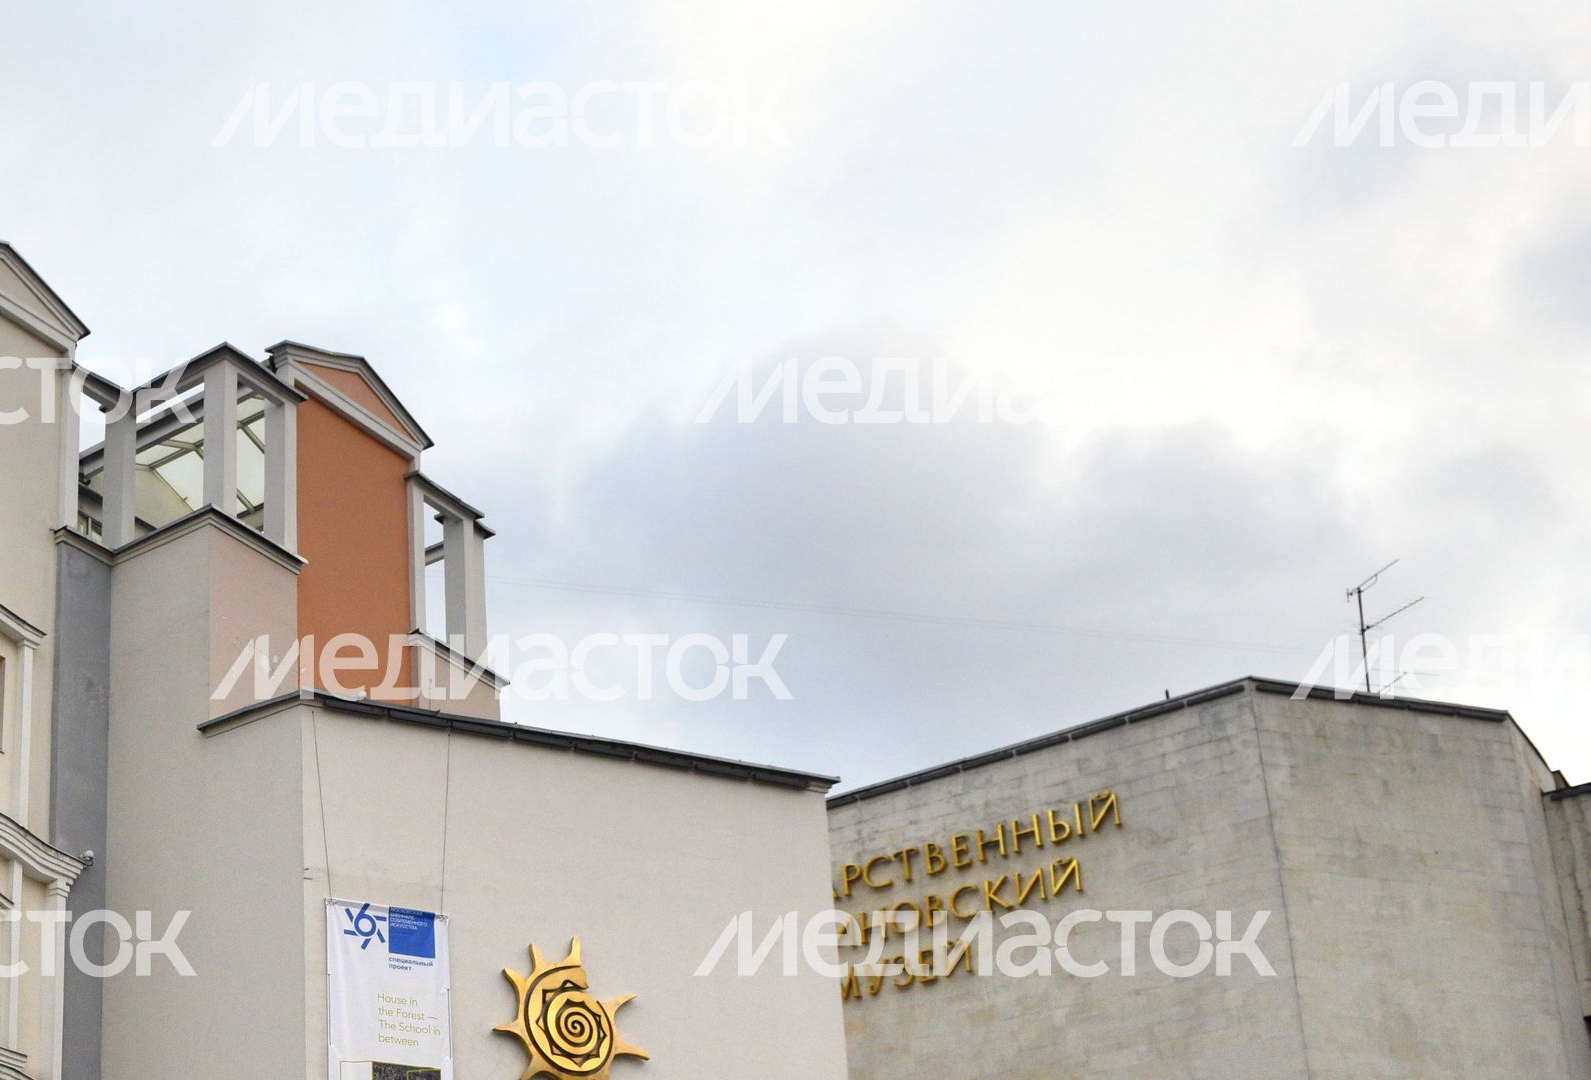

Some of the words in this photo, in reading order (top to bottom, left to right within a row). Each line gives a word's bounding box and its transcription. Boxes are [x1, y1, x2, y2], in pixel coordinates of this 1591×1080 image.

[832, 790, 1123, 899] РСТВЕННЫЙ
[389, 957, 434, 967] специальный
[389, 963, 412, 971] проект
[377, 992, 407, 1005] House
[409, 997, 418, 1006] in
[378, 1006, 394, 1017] the
[396, 1008, 425, 1021] Forest
[378, 1019, 396, 1030] The
[399, 1022, 431, 1034] School
[378, 1032, 419, 1046] between
